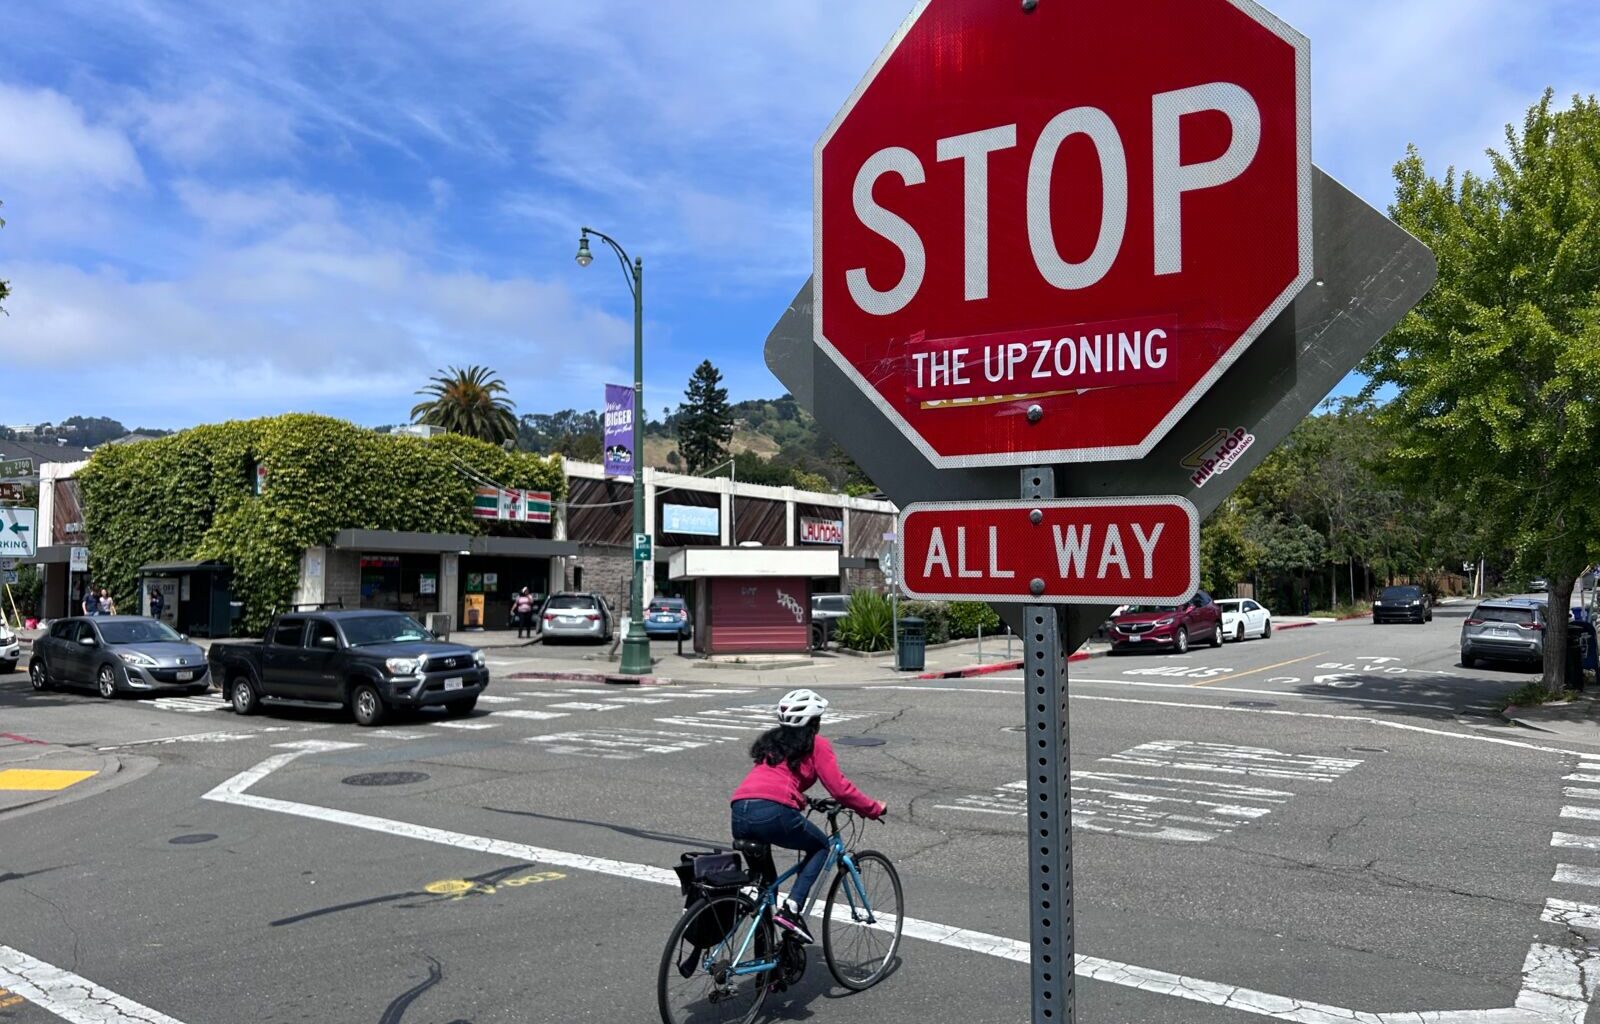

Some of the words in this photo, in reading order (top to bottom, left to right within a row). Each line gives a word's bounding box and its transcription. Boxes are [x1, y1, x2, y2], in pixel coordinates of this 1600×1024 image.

[845, 81, 1261, 316] STOP
[912, 348, 970, 388] THE
[984, 328, 1168, 383] UPZONING
[605, 410, 632, 427] BIGGER
[1191, 427, 1245, 486] HIP-HOP
[1228, 436, 1253, 462] ITALIANO
[0, 540, 28, 548] KING
[800, 523, 843, 542] LAUNDRY
[922, 526, 1015, 578] ALL
[1053, 522, 1165, 580] WAY
[1315, 662, 1408, 674] BLVD
